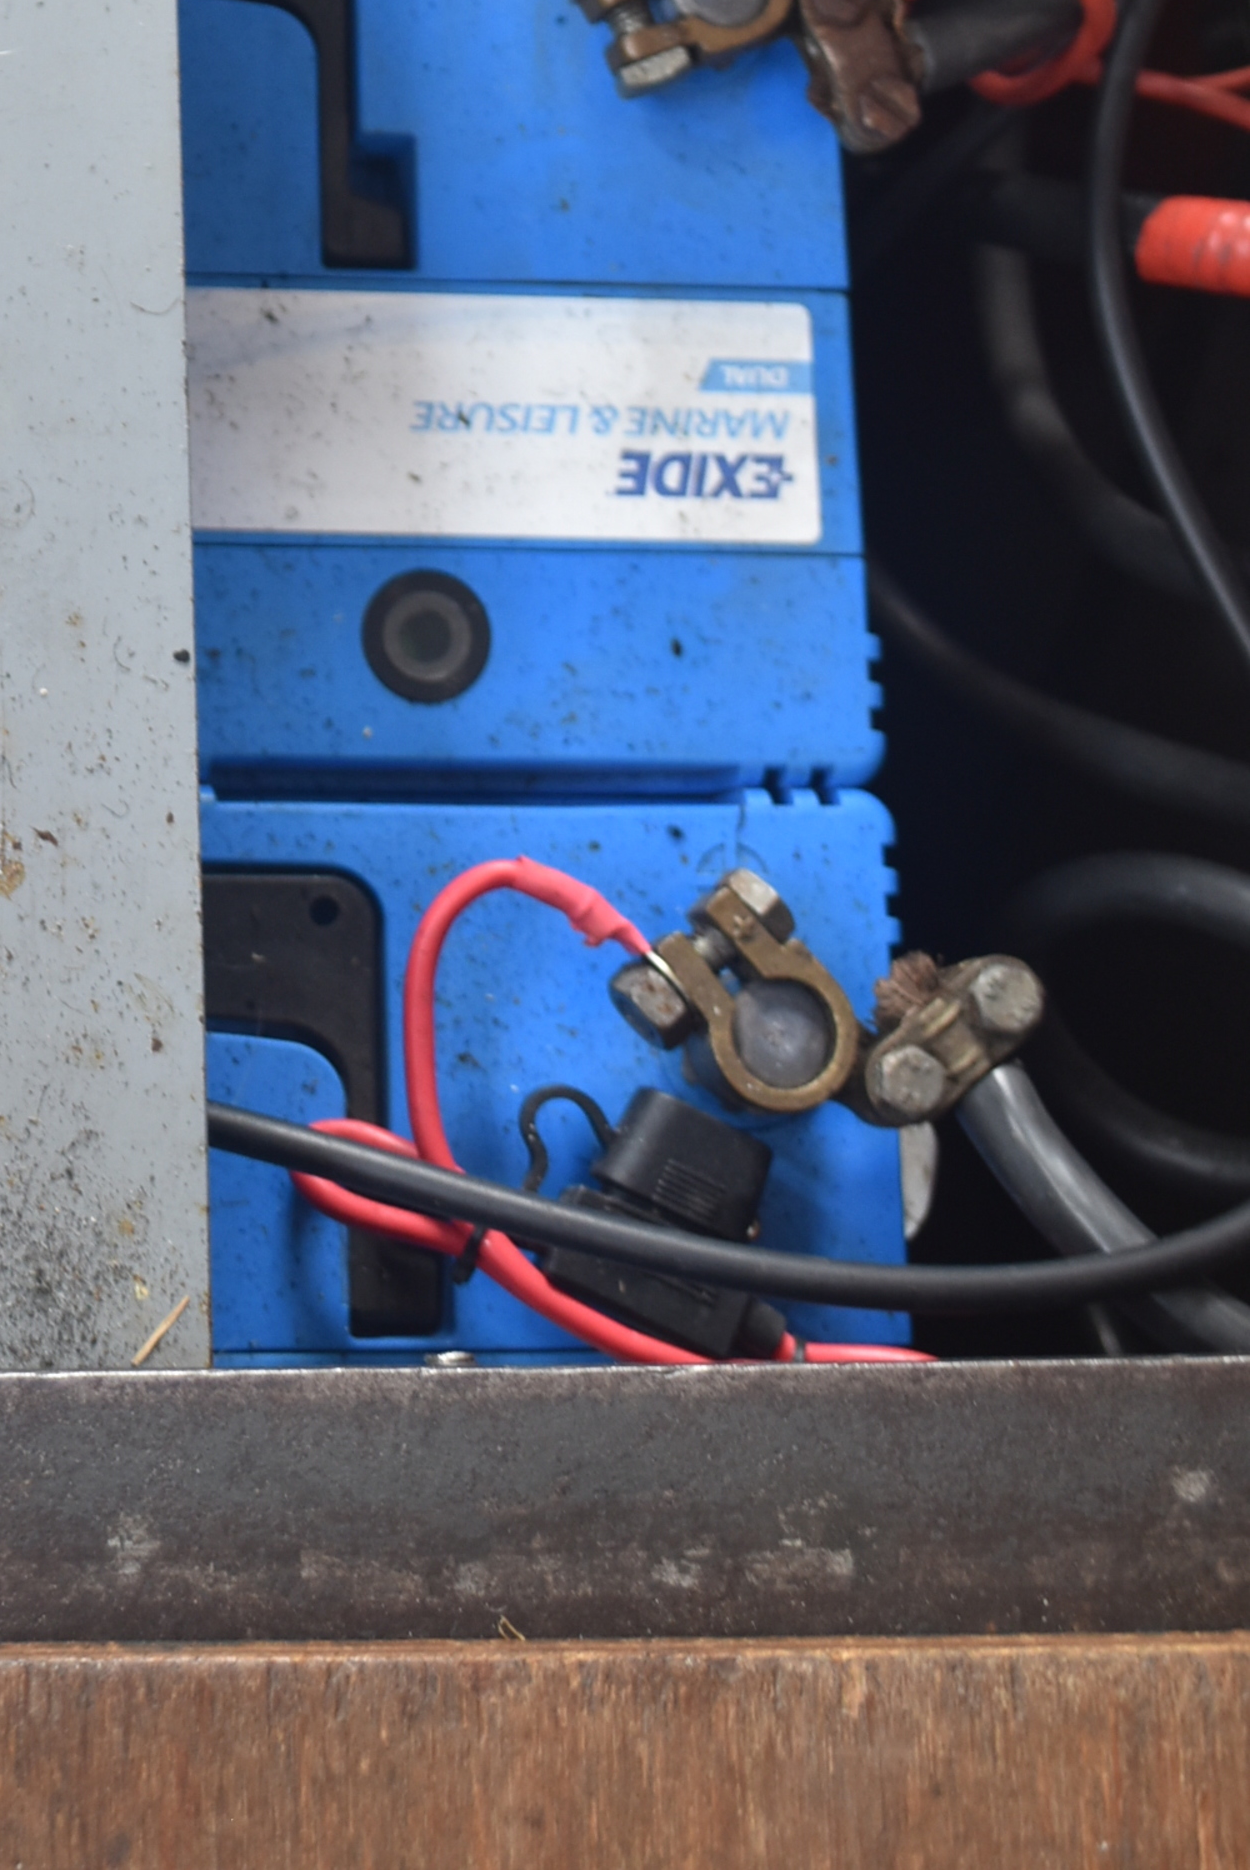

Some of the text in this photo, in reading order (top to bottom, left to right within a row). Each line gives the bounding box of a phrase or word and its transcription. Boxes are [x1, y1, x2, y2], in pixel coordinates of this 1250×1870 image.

[719, 364, 789, 388] DUAL
[410, 399, 791, 440] MARINE & LEISURE
[614, 449, 794, 500] EXIDE
